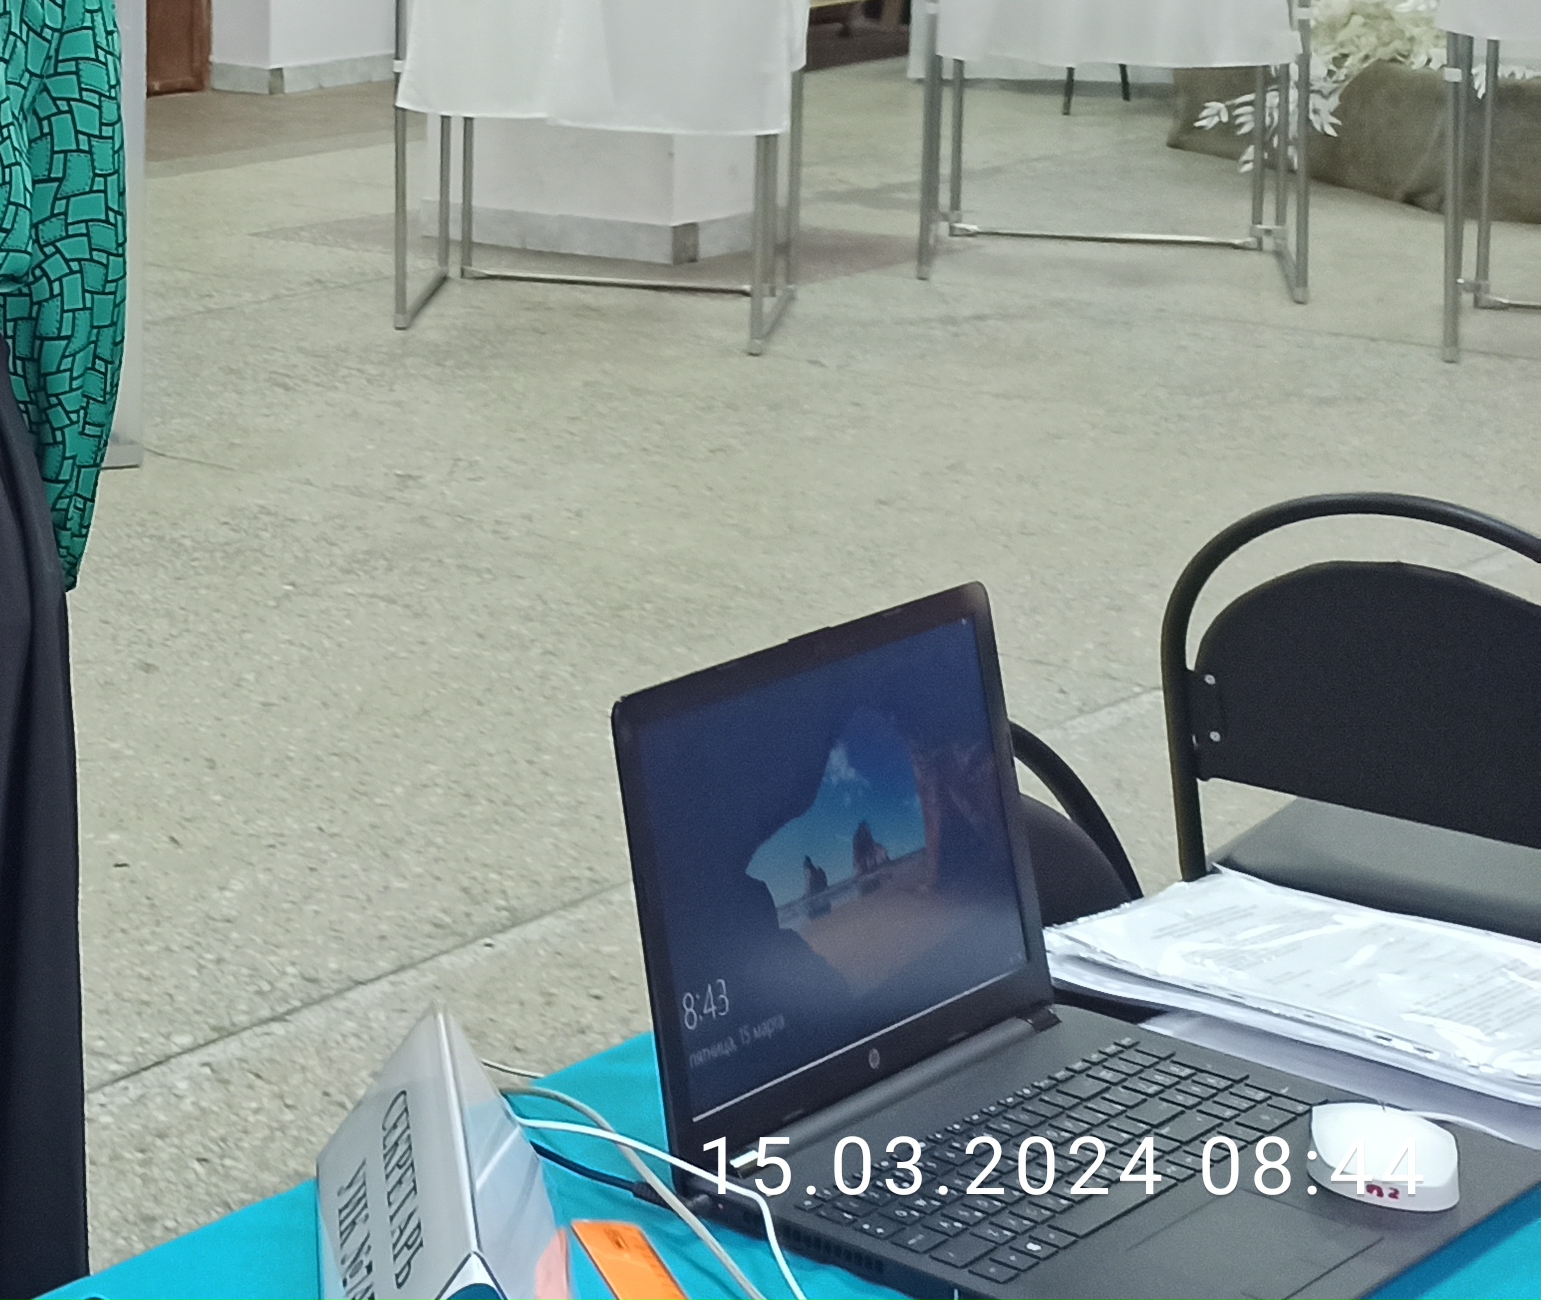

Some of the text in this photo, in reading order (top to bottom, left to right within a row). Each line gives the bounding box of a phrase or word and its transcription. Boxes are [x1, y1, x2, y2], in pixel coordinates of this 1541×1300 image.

[682, 978, 730, 1030] 8:43
[739, 1023, 752, 1045] 15
[753, 1013, 786, 1039] марта
[337, 1157, 369, 1250] УИК
[382, 1089, 424, 1289] СЕКРЕТАРЬ
